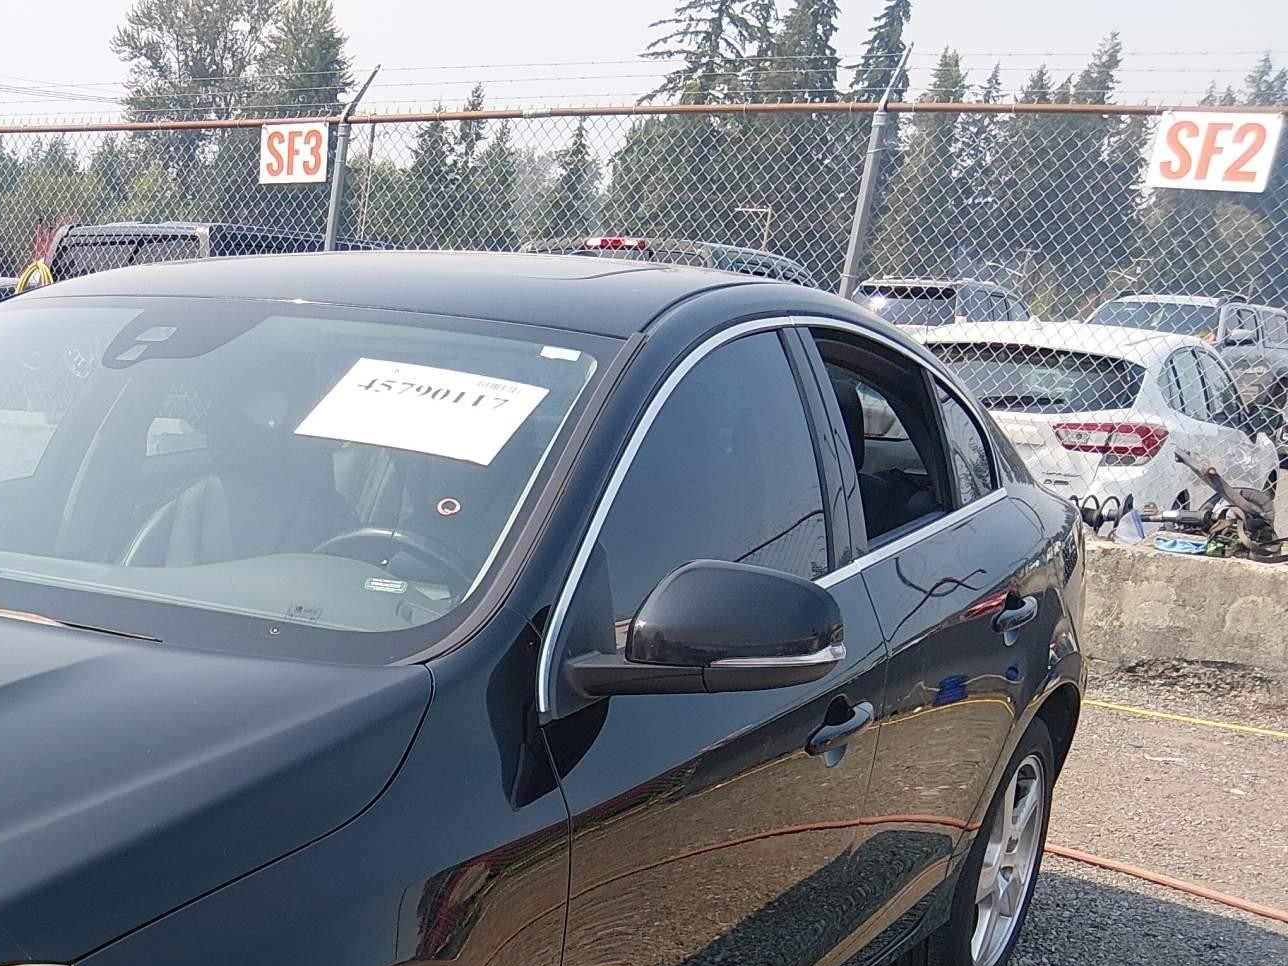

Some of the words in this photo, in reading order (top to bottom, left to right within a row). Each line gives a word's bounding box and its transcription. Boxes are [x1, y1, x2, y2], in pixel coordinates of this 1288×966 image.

[265, 129, 323, 177] SF3
[1159, 120, 1267, 183] SF2
[356, 377, 511, 410] 45790117
